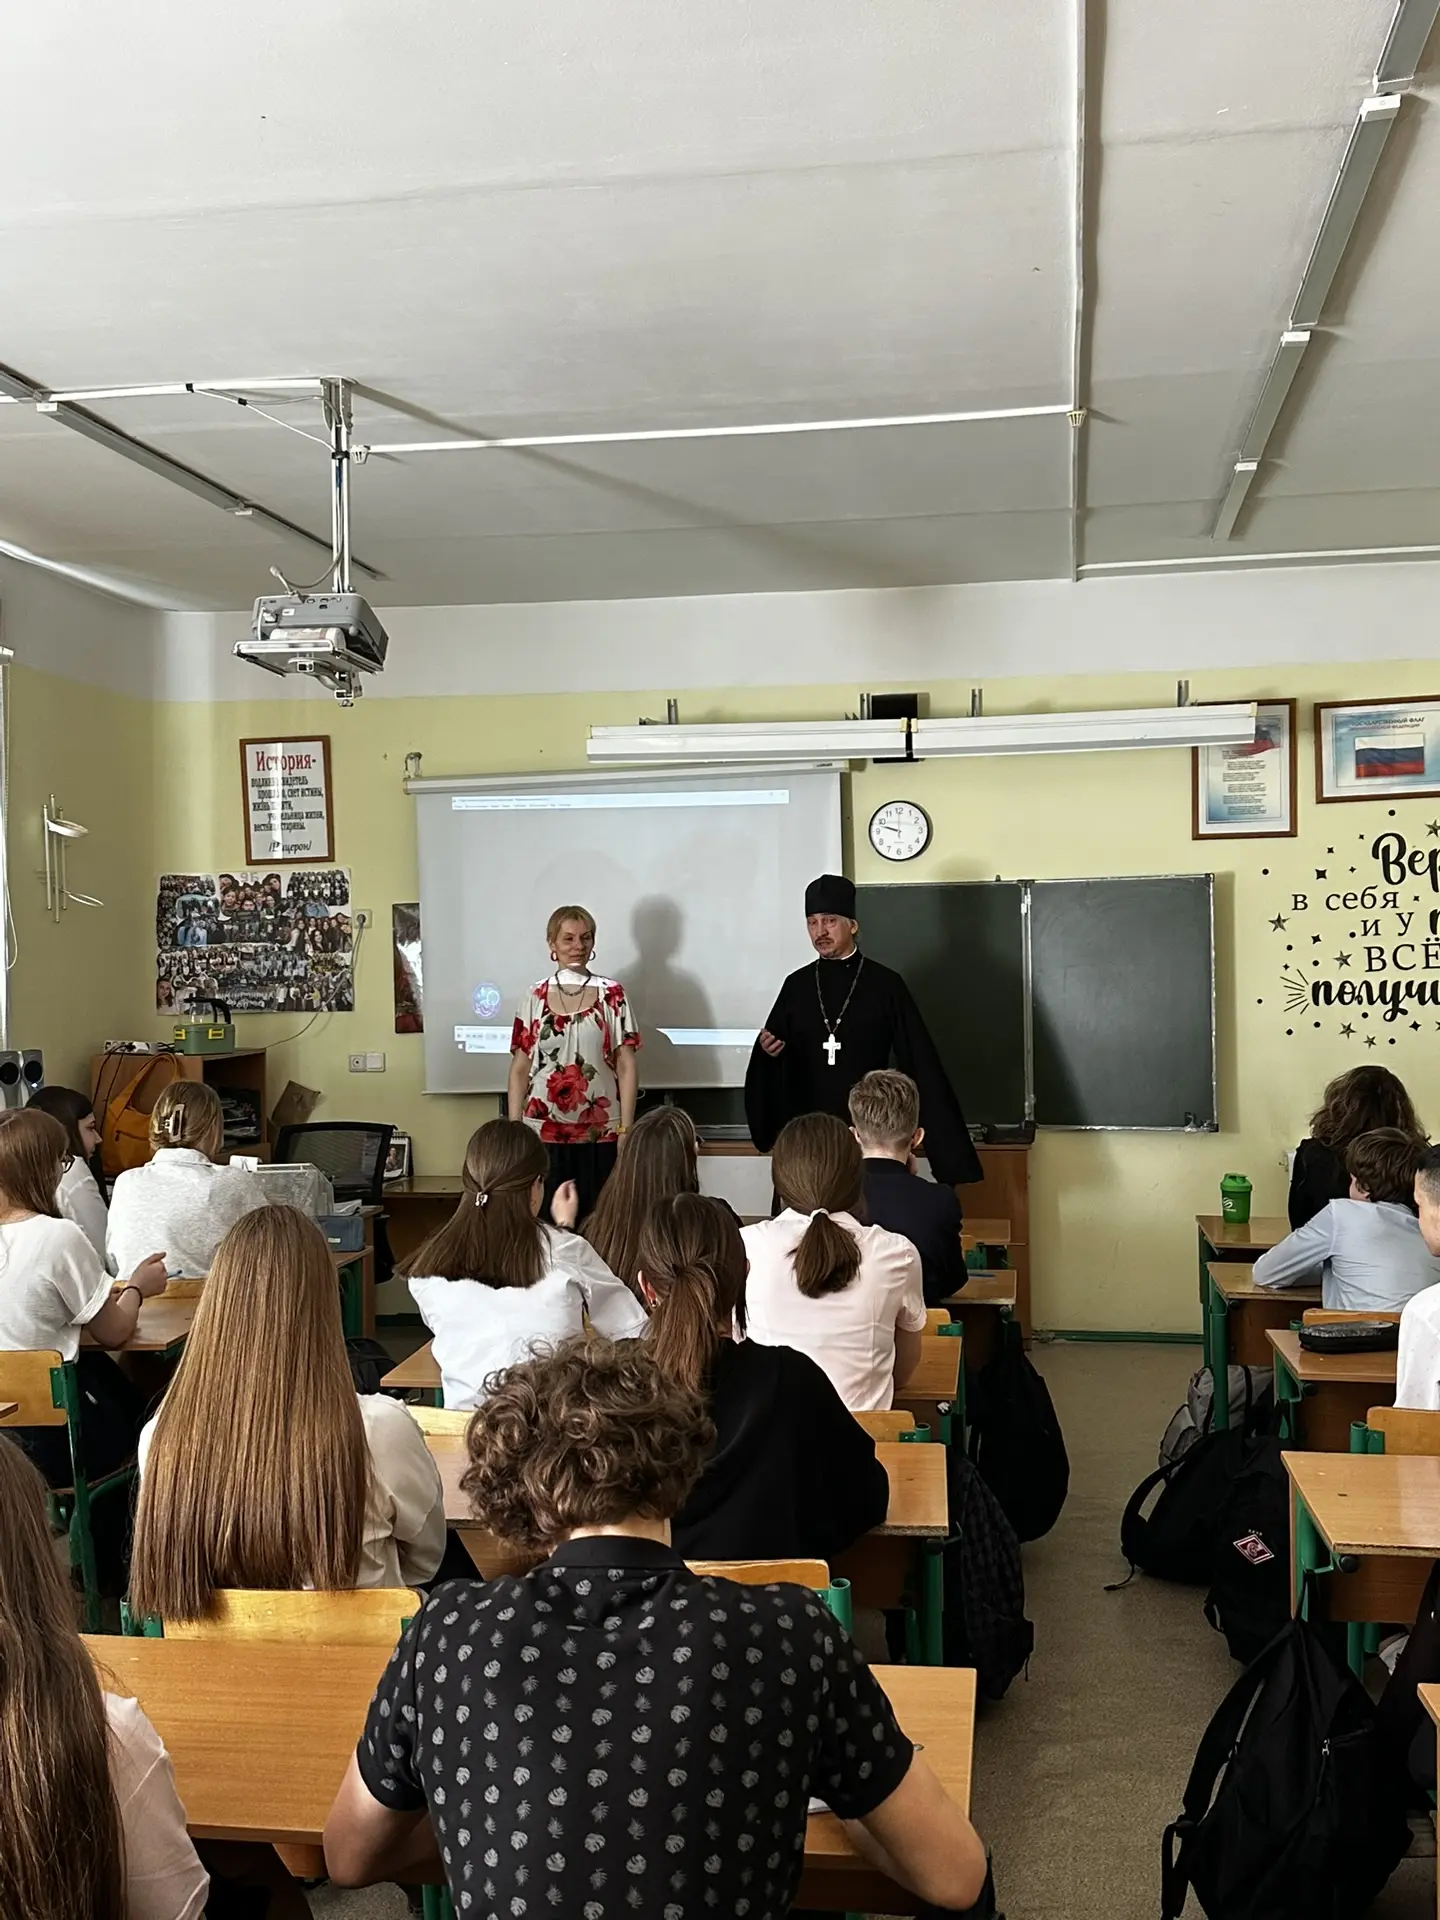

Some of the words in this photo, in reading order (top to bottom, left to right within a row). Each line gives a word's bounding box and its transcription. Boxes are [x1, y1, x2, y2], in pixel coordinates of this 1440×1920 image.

[885, 810, 893, 818] 11
[895, 807, 904, 815] 12
[914, 816, 920, 824] 2
[918, 826, 924, 834] 3
[878, 838, 884, 846] 8
[907, 844, 913, 852] 5
[1291, 893, 1308, 911] в
[1325, 885, 1400, 911] себя
[1361, 919, 1381, 937] и
[1395, 911, 1415, 937] у
[1363, 937, 1440, 973] ВСЁ
